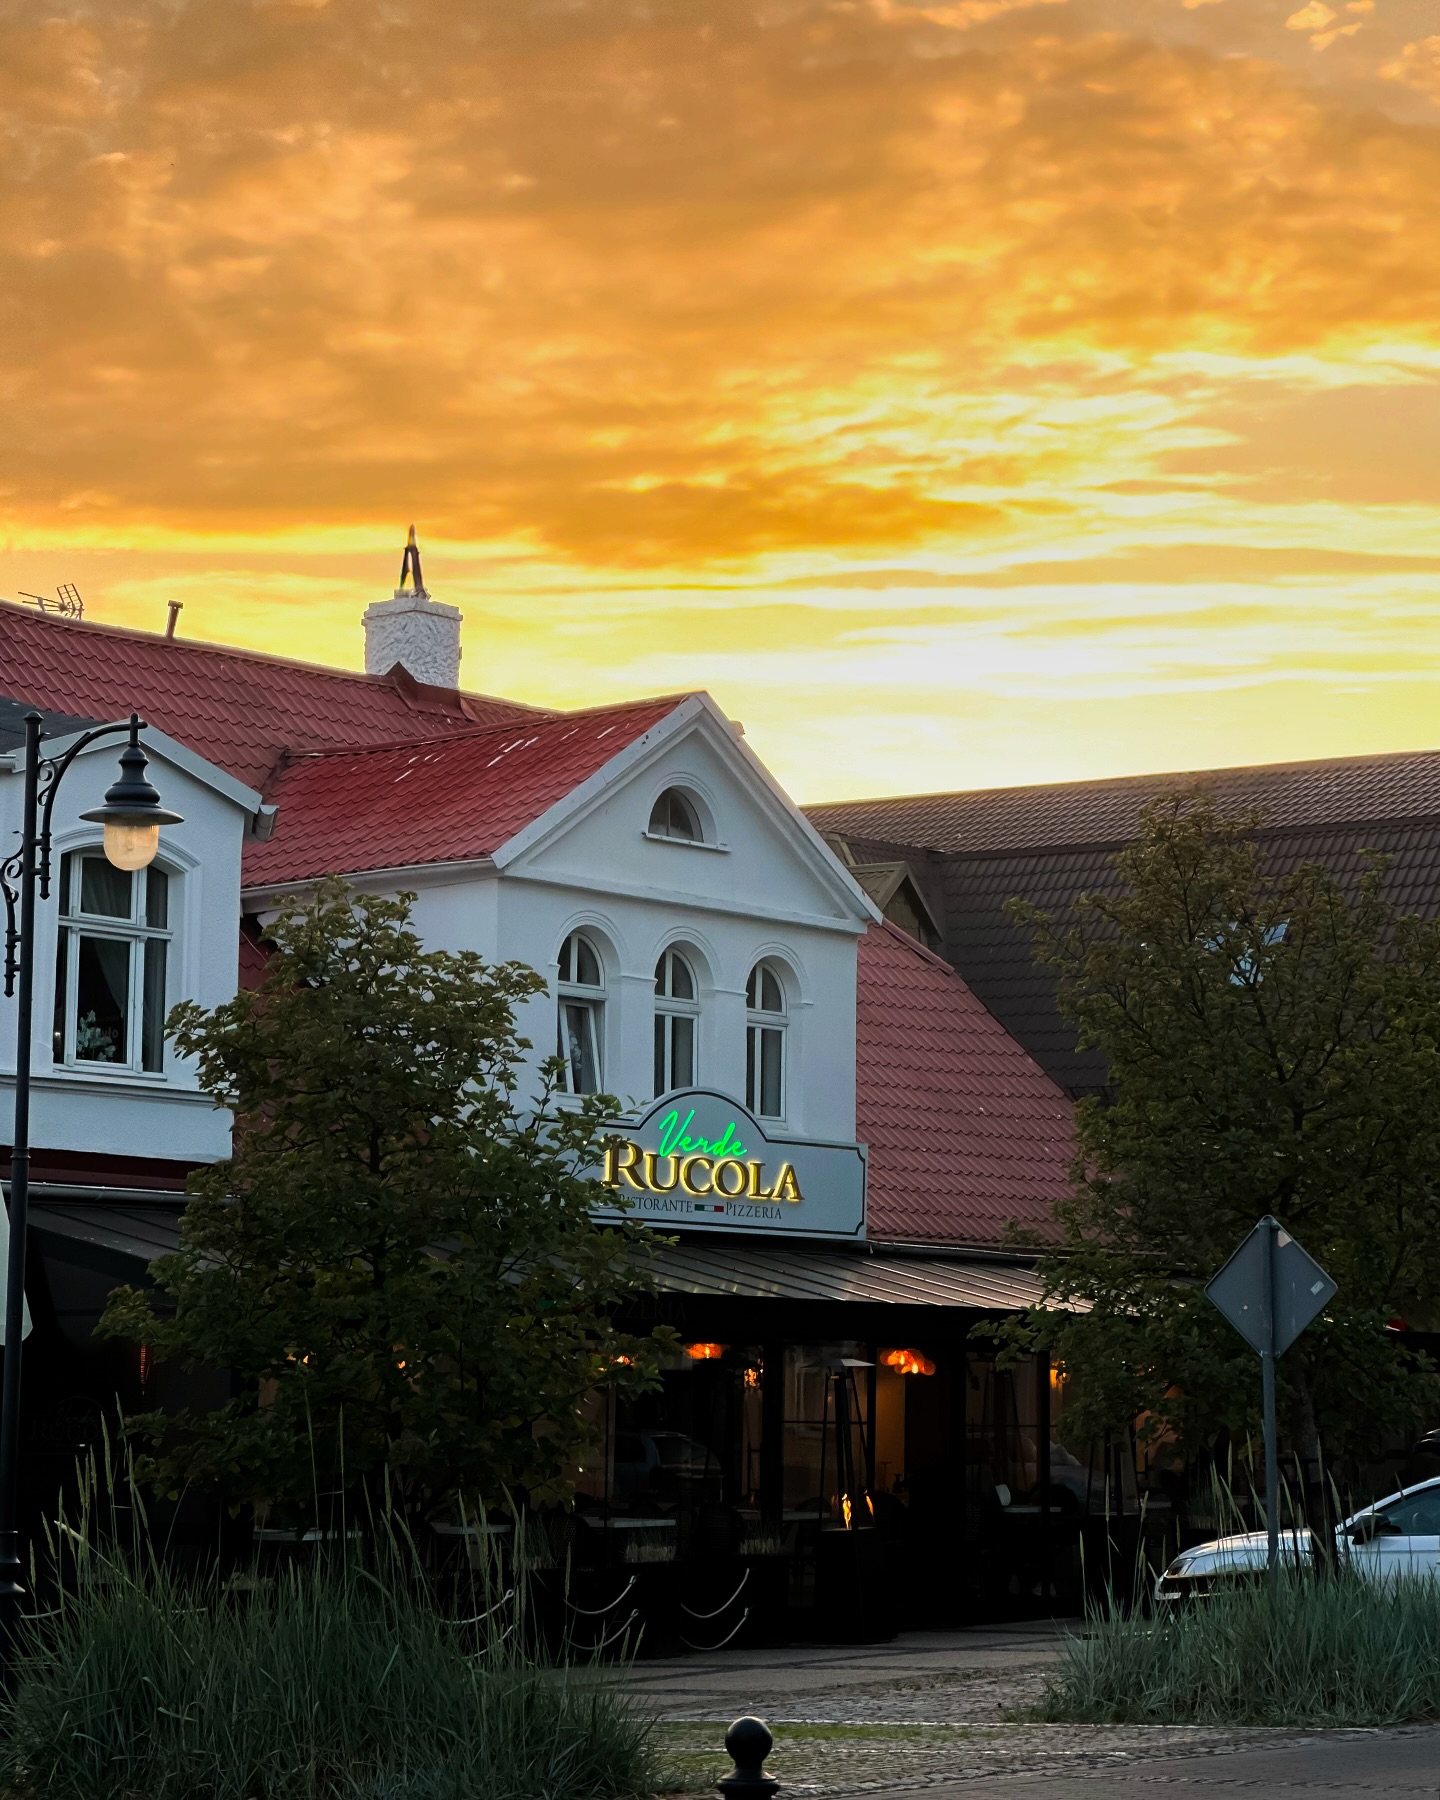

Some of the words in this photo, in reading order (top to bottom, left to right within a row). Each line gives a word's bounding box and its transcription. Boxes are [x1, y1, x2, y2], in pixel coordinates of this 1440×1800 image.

[659, 1109, 748, 1157] Verde
[601, 1139, 805, 1202] RUCOLA
[725, 1201, 782, 1220] PIZZERIA
